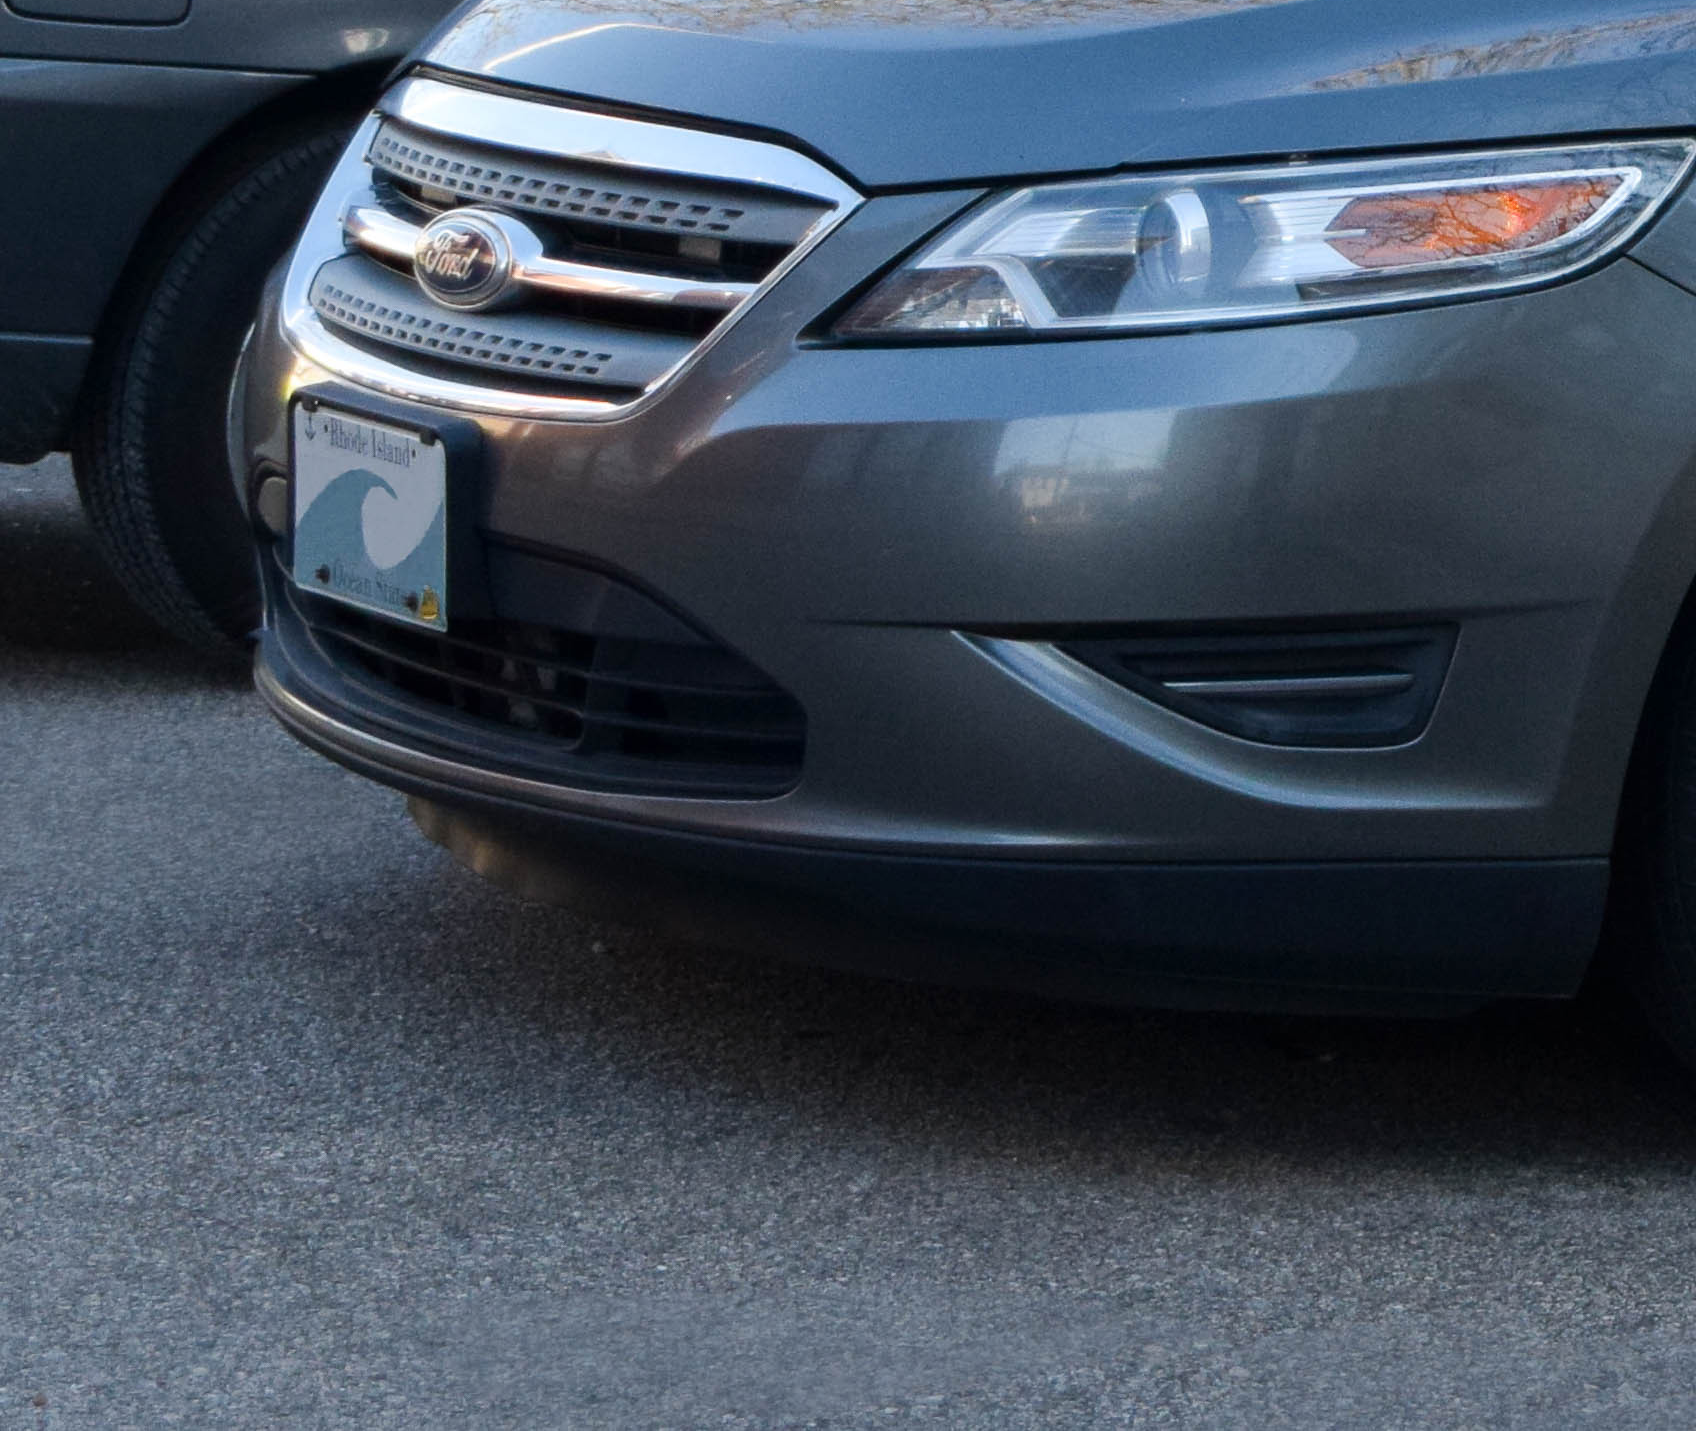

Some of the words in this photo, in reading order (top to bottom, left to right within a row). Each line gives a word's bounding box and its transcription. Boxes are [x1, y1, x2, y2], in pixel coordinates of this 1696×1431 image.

[424, 229, 480, 281] Ford
[330, 418, 368, 455] Rhode
[372, 432, 410, 468] Island
